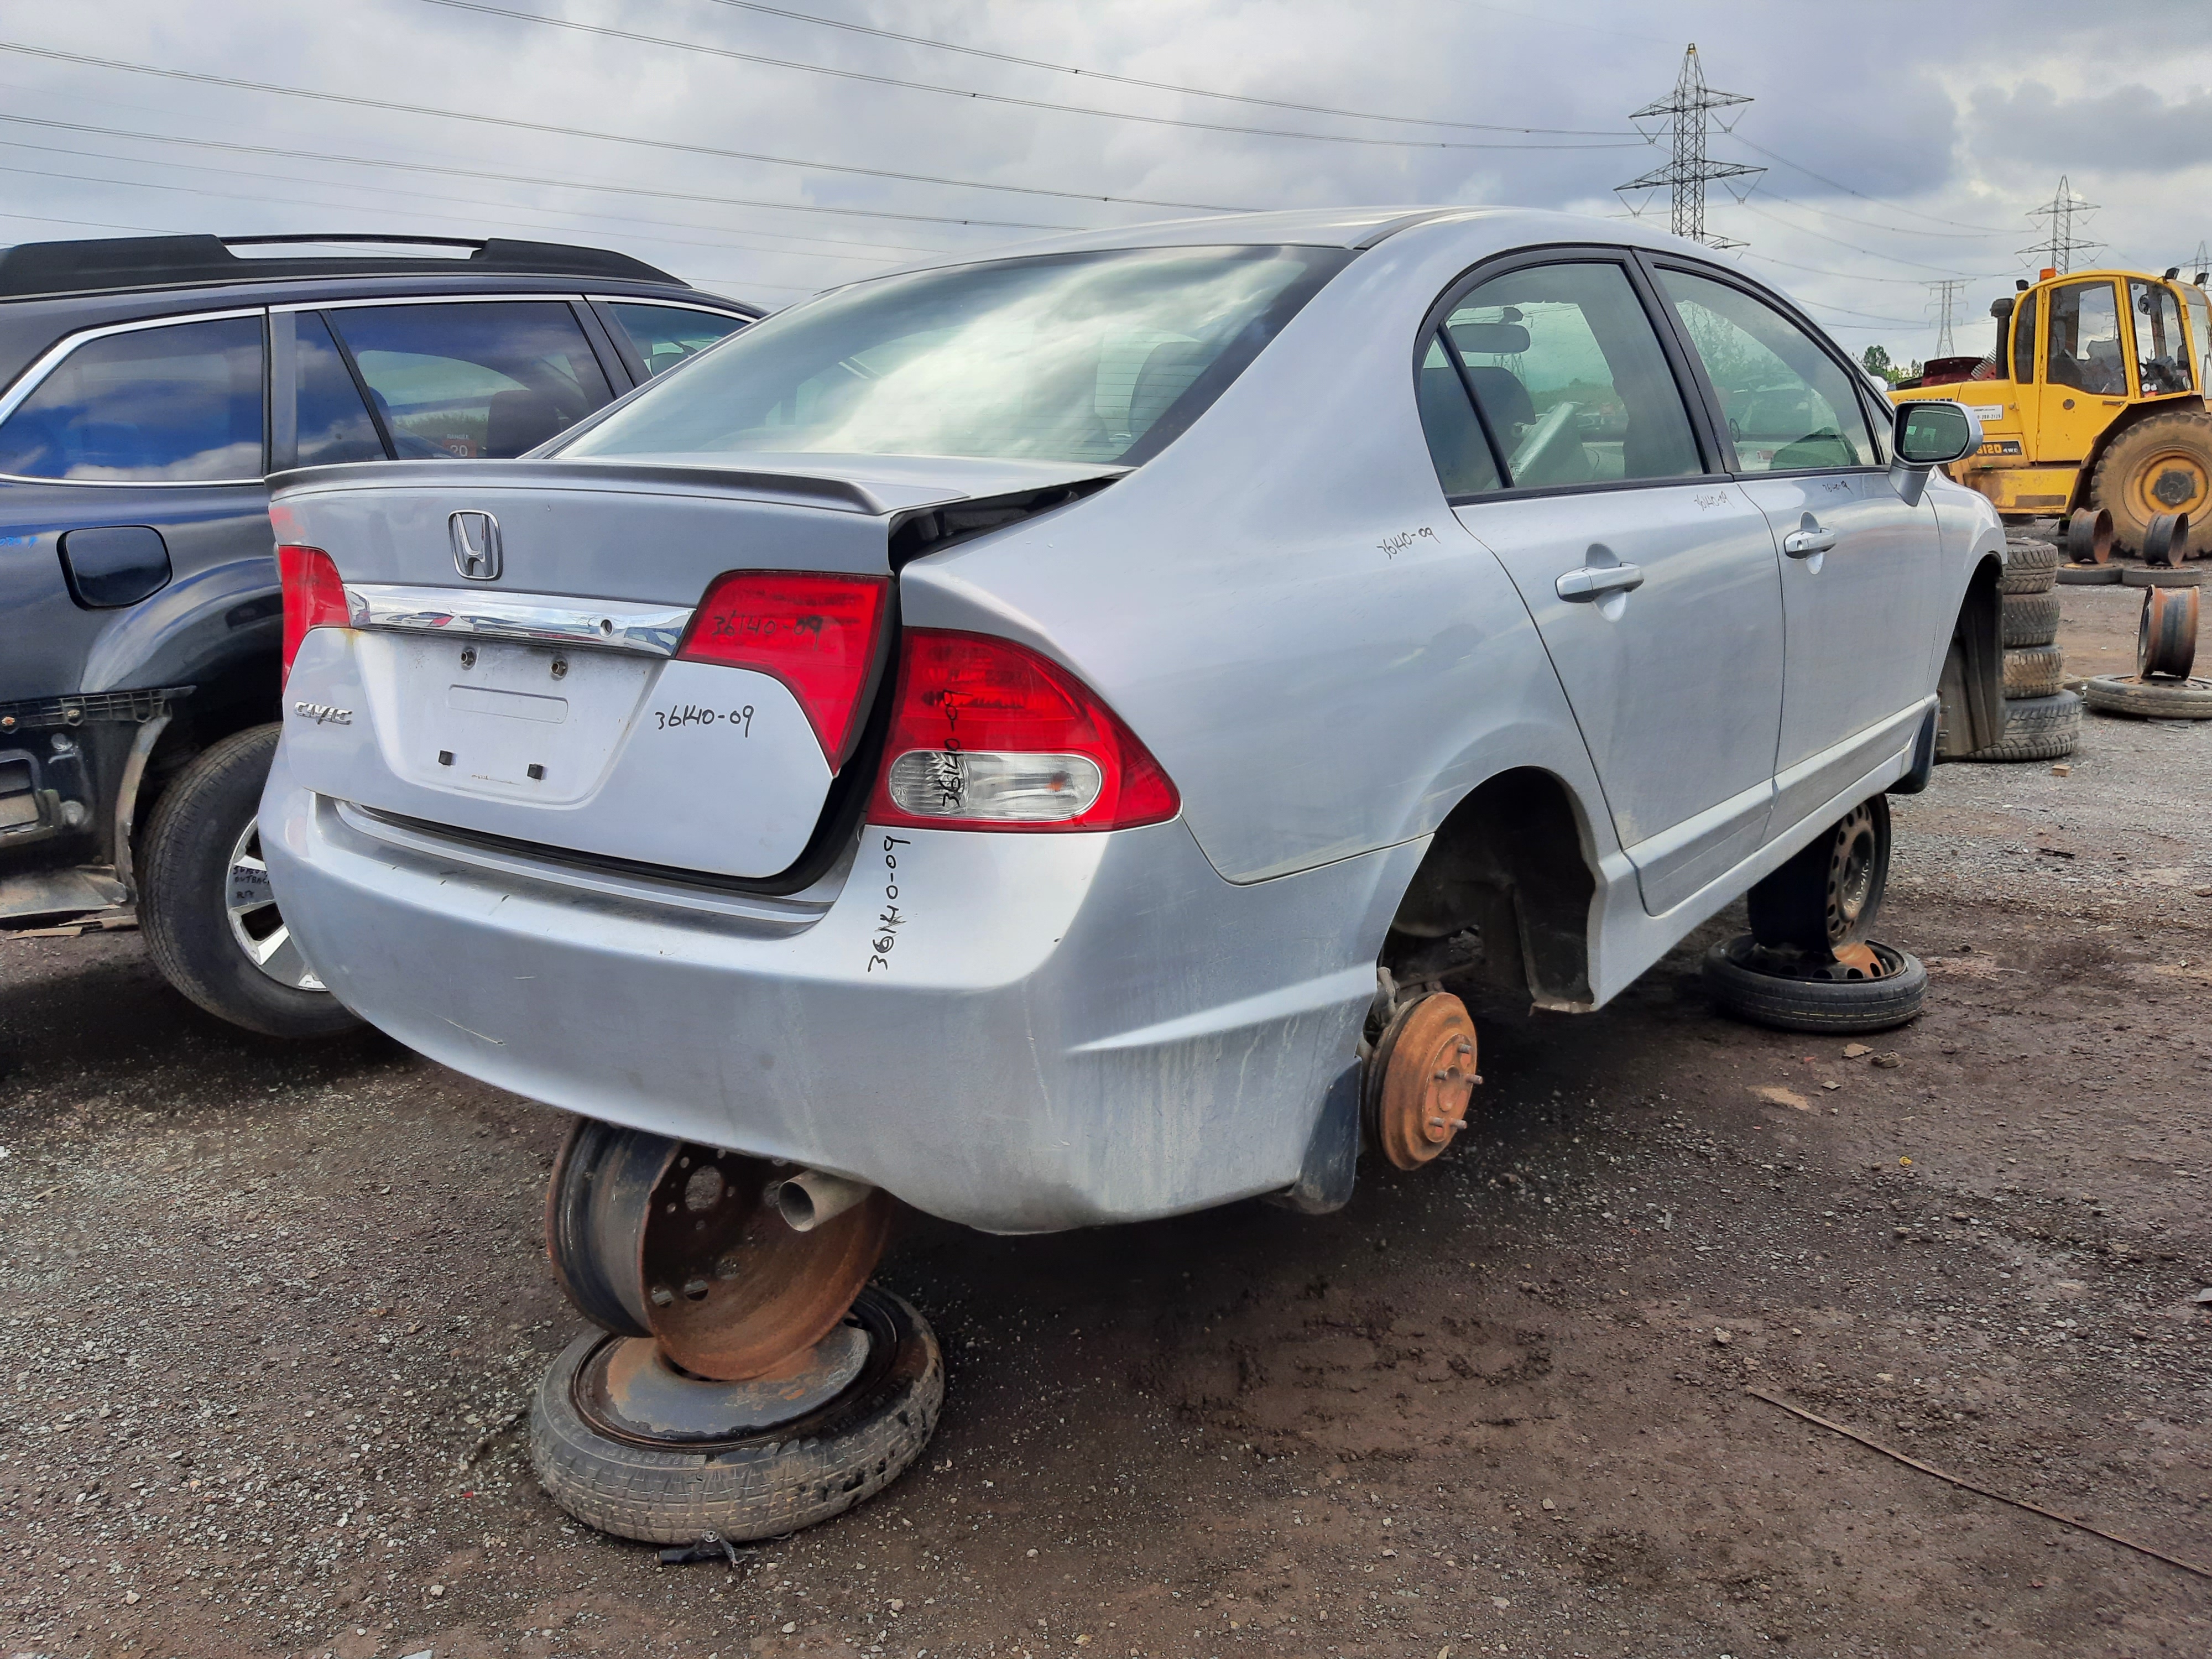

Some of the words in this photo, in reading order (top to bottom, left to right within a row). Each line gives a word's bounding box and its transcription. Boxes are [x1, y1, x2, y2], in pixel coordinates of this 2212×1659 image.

[712, 610, 823, 651] 36140-09
[294, 701, 353, 725] CIVIC
[655, 705, 754, 738] 36140-09
[938, 689, 973, 807] 36140-09
[234, 875, 270, 885] OUTBAC
[867, 835, 911, 973] 36140-09
